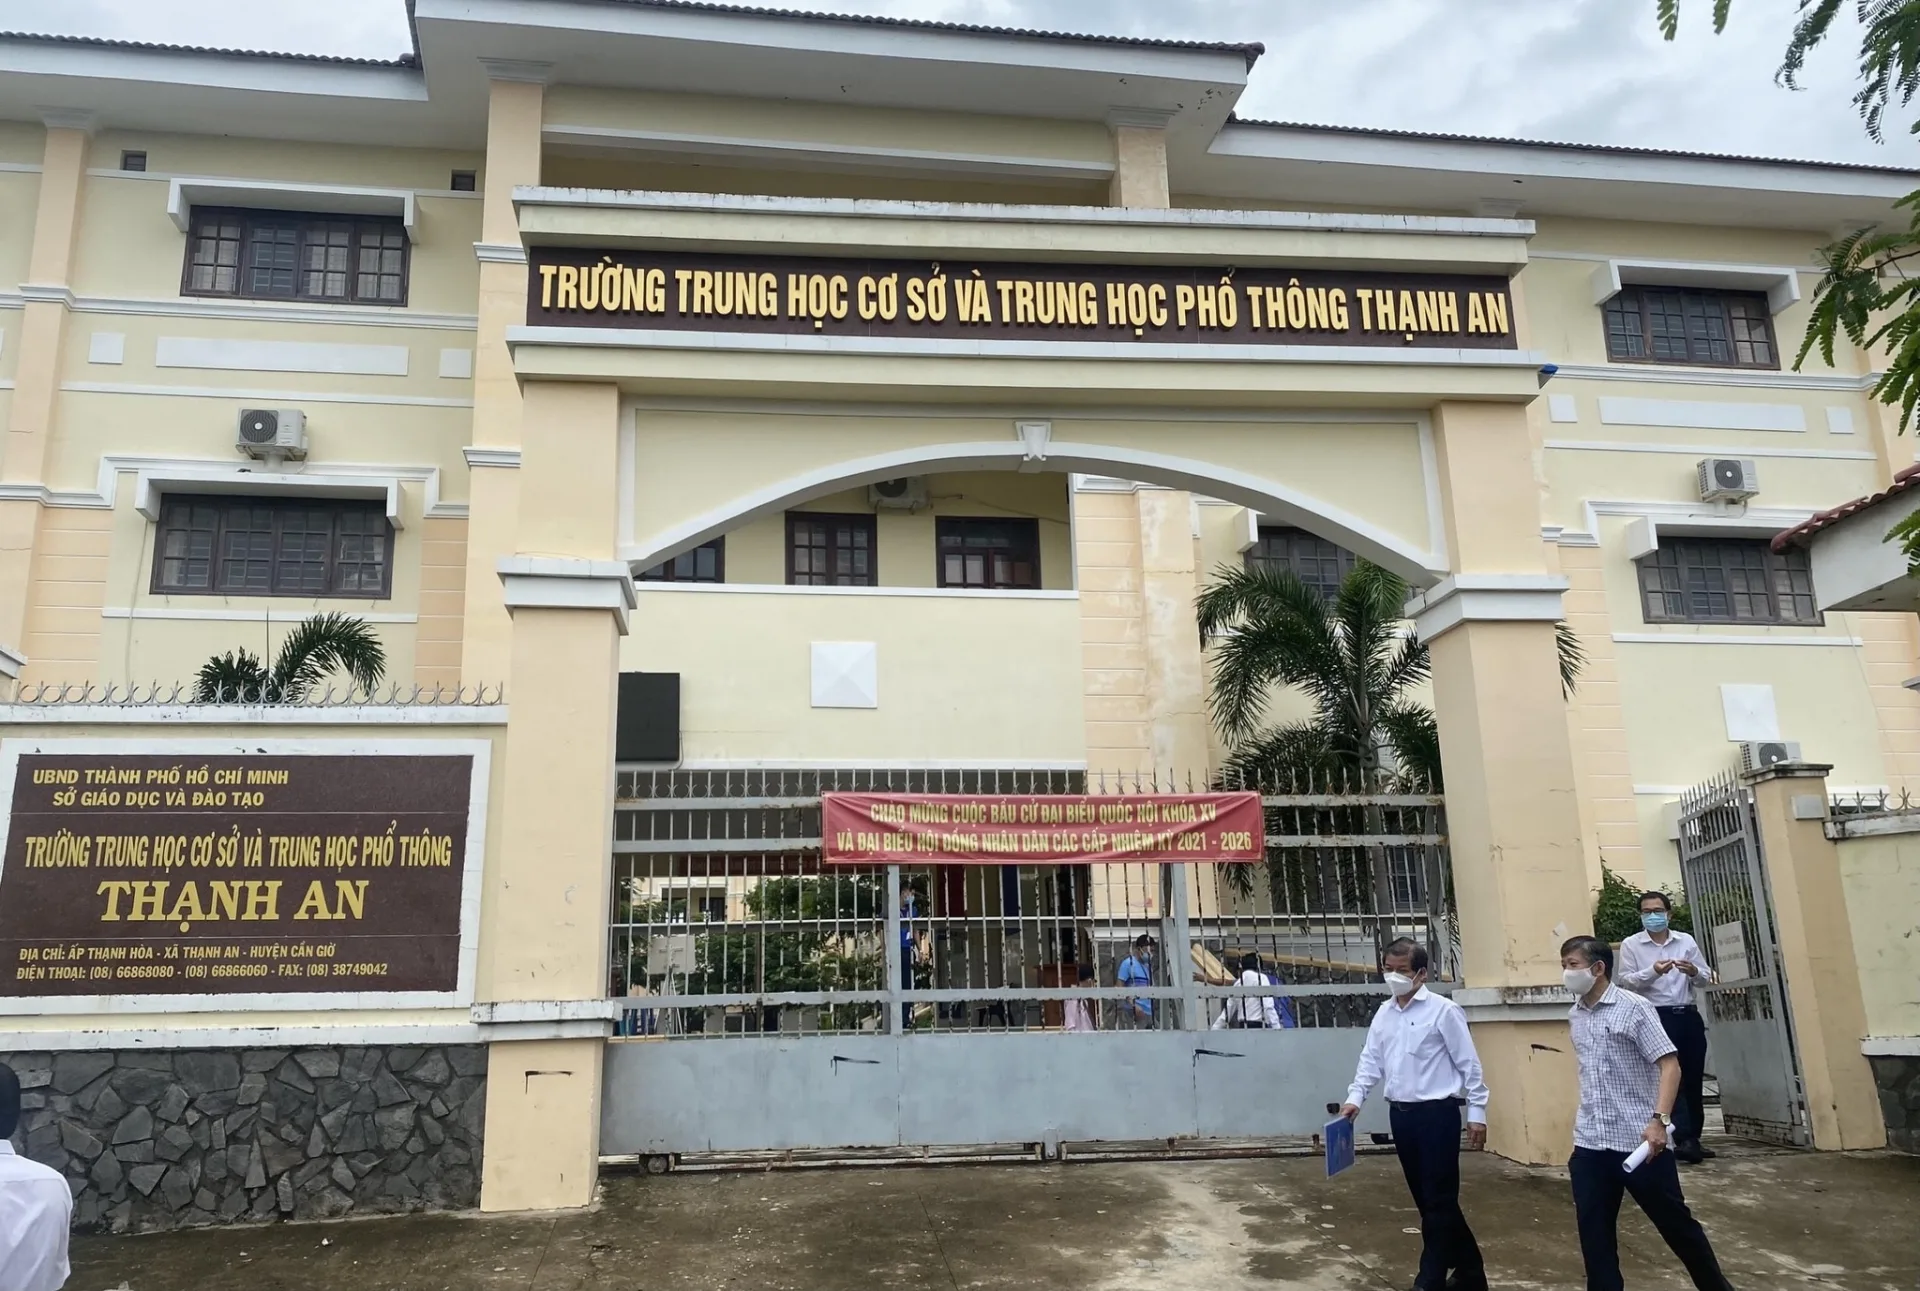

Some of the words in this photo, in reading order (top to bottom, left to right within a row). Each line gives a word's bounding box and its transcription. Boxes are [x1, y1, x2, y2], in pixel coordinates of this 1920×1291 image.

[540, 256, 665, 314] TRƯỜNG
[674, 269, 777, 317] TRUNG
[788, 274, 848, 329] HỌC
[857, 272, 898, 321] CƠ
[906, 261, 948, 323] SỞ
[954, 269, 992, 323] VÀ
[997, 280, 1098, 326] TRUNG
[1106, 282, 1168, 337] HỌC
[1176, 266, 1238, 328] PHỔ
[1247, 277, 1349, 331] THÔNG
[1356, 288, 1460, 341] THẠNH
[1467, 292, 1509, 334] AN
[33, 769, 79, 785] UBND
[85, 765, 141, 785] THÀNH
[146, 764, 183, 784] PHỐ
[186, 764, 210, 784] HỒ
[214, 766, 243, 784] CHÍ
[247, 769, 289, 784] MINH
[53, 786, 78, 806] SỞ
[81, 788, 120, 806] GIÁO
[125, 791, 161, 809] DỤC
[165, 787, 187, 806] VÀ
[192, 787, 227, 806] ĐÀO
[231, 791, 265, 809] TẠO
[870, 800, 905, 823] CHÀO
[909, 800, 949, 824] MỪNG
[952, 801, 987, 828] CUỘC
[1020, 798, 1038, 823] CỬ
[1041, 803, 1062, 828] ĐẠI
[1066, 796, 1096, 823] BIỂU
[1099, 797, 1133, 826] QUỐC
[1137, 800, 1159, 827] HỘI
[1162, 799, 1197, 823] KHÓA
[1200, 803, 1217, 822] XV
[25, 827, 91, 868] TRƯỜNG
[95, 836, 148, 867] TRUNG
[152, 836, 187, 874] HỌC
[190, 831, 216, 867] CƠ
[216, 823, 242, 867] SỞ
[243, 828, 263, 867] VÀ
[269, 836, 321, 867] TRUNG
[324, 836, 358, 873] HỌC
[361, 819, 397, 867] PHỔ
[399, 828, 452, 867] THÔNG
[837, 828, 854, 851] VÀ
[857, 832, 880, 856] ĐẠI
[883, 825, 913, 852] BIỂU
[917, 829, 939, 857] HỘI
[982, 830, 1019, 852] NHÂN
[1022, 830, 1049, 852] DÂN
[1052, 829, 1079, 852] CÁC
[1081, 826, 1108, 852] CẤP
[1111, 829, 1154, 856] NHIỆM
[1157, 829, 1174, 851] KỲ
[1177, 831, 1207, 851] 2021
[1220, 831, 1252, 851] 2026
[97, 880, 283, 932] THẠNH
[293, 880, 369, 920] AN
[19, 947, 41, 963] ĐỊA
[42, 943, 66, 961] CHỈ:
[67, 943, 86, 961] ẤP
[88, 946, 129, 963] THẠNH
[129, 944, 153, 960] HÒA
[163, 944, 179, 959] XÃ
[183, 946, 222, 962] THẠNH
[224, 946, 240, 958] AN
[250, 942, 288, 961] HUYỆN
[316, 942, 337, 958] GIỜ
[16, 964, 46, 982] ĐIỆN
[48, 966, 86, 982] THOẠI:
[90, 966, 114, 980] (08)
[116, 965, 174, 979] 66868080
[185, 965, 208, 979] (08)
[211, 964, 268, 978] 66866060
[278, 964, 303, 977] FAX:
[306, 964, 329, 978] (08)
[332, 963, 388, 976] 38749042
